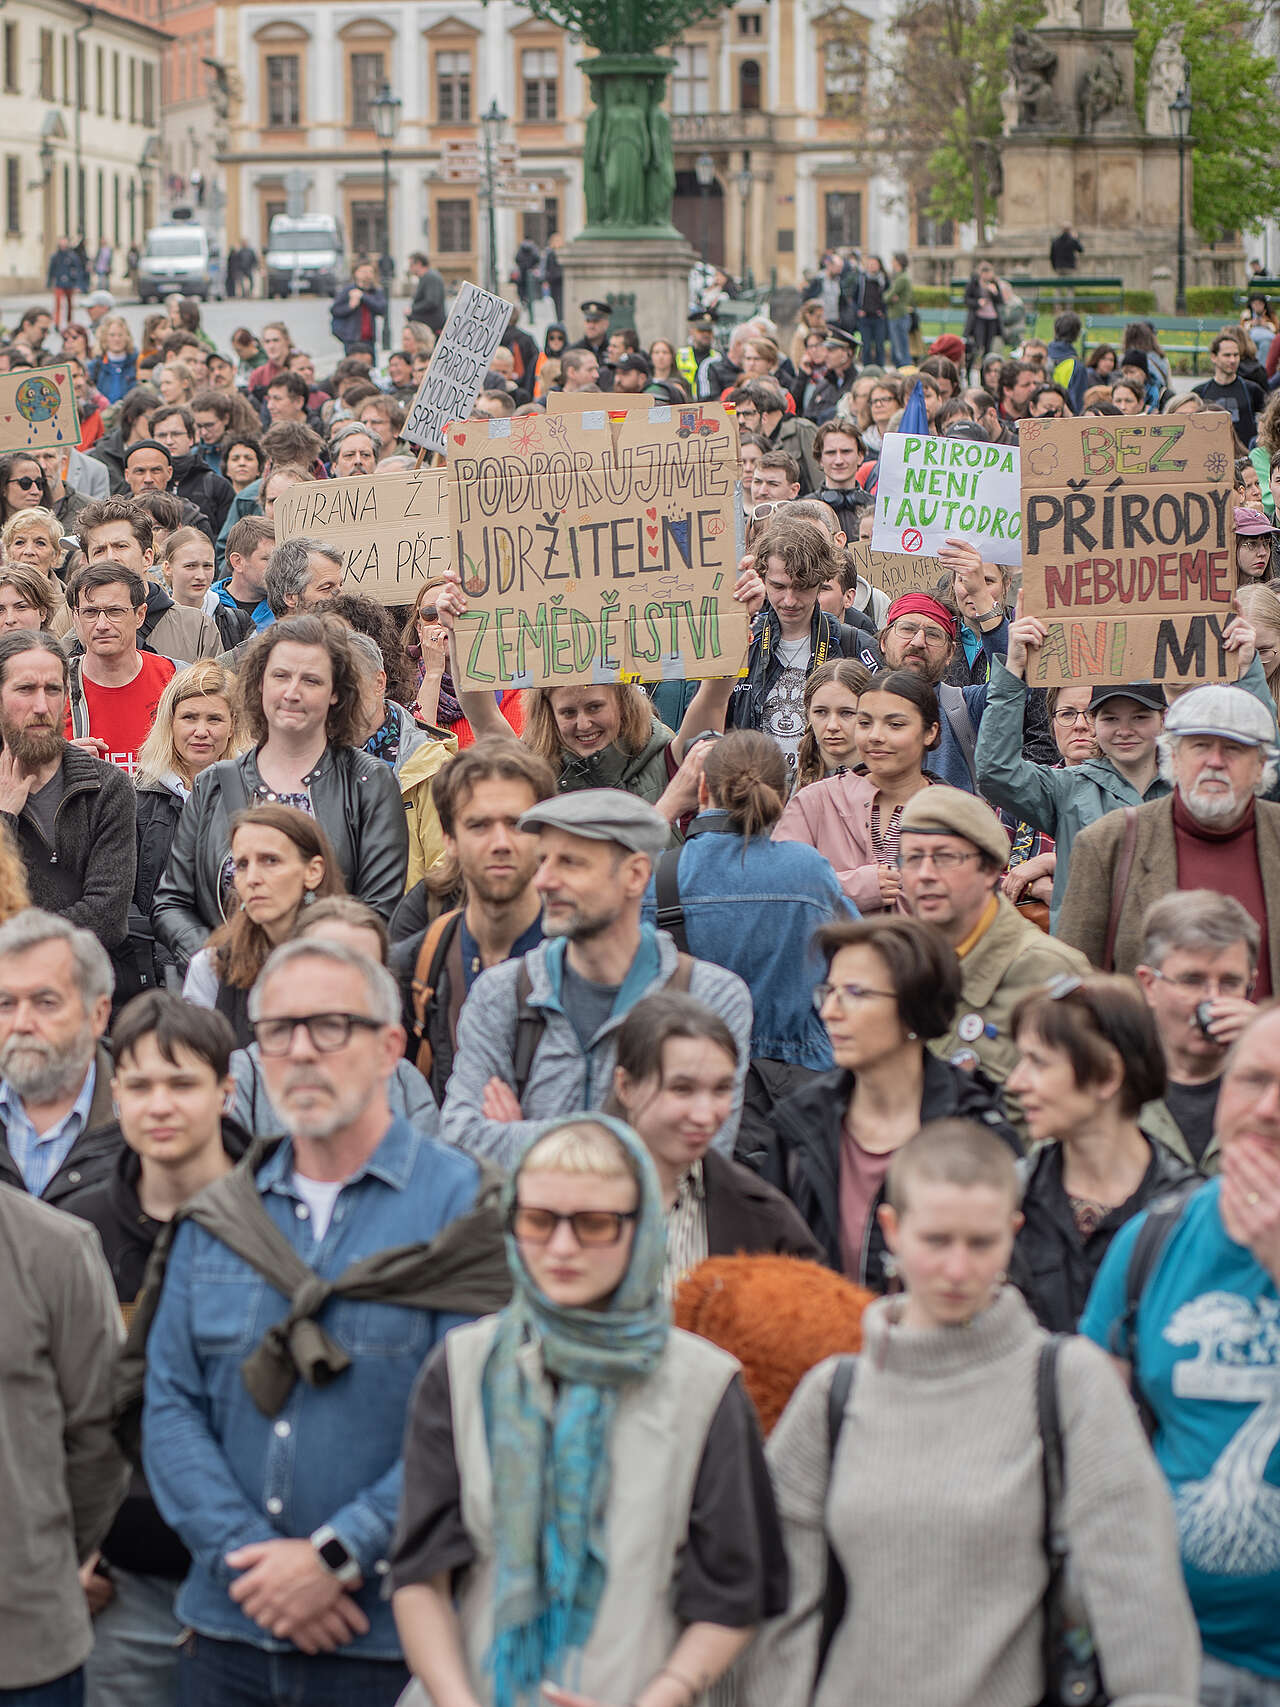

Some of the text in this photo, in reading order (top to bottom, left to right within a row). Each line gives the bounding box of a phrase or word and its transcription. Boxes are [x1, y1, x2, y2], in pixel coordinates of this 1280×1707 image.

[445, 315, 500, 358] SVOBODU
[903, 436, 1014, 473] PŘÍRODA
[1081, 425, 1188, 475] BEZ
[455, 435, 730, 524] PODPORUJME
[903, 467, 984, 501] NENÍ
[1026, 476, 1232, 556] PŘÍRODY
[1044, 549, 1232, 610] NEBUDEME
[456, 572, 725, 683] ZEMĚDĚLSTVÍ
[762, 626, 770, 650] Nikon
[1036, 612, 1238, 681] ANI MY
